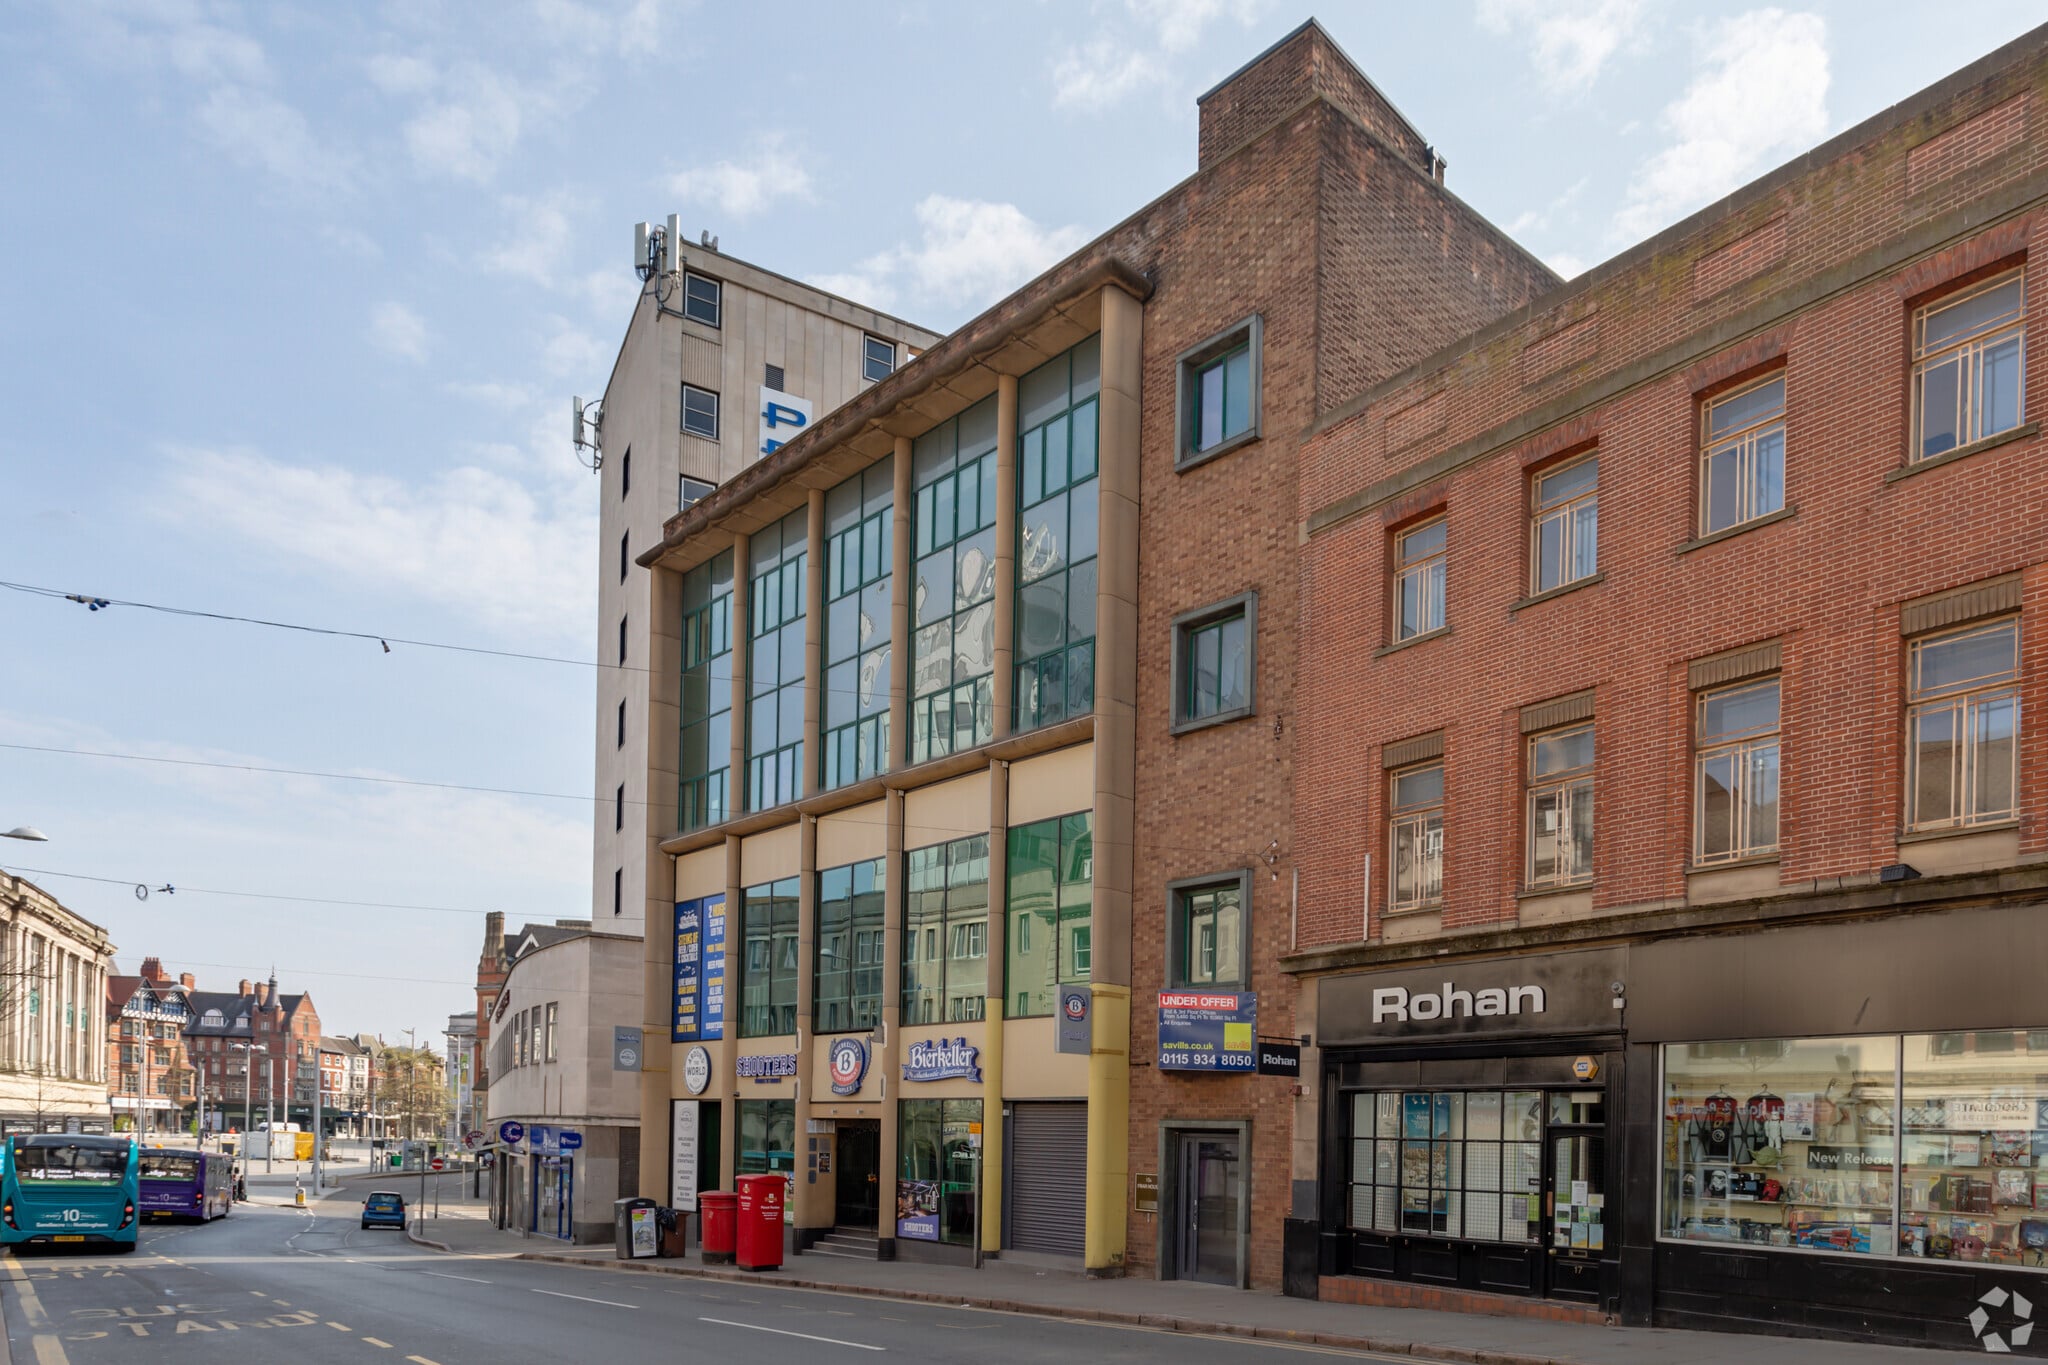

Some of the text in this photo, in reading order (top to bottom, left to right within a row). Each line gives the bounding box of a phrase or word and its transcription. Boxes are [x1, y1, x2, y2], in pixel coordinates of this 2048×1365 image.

[1162, 996, 1234, 1007] UNDER OFFER
[1373, 982, 1545, 1023] Rohan
[1163, 1042, 1214, 1050] savills.co.uk
[841, 1052, 851, 1072] B
[911, 1044, 973, 1068] Bierkeller
[1162, 1053, 1252, 1066] 0115 934 8050
[1263, 1053, 1297, 1067] Rohan
[687, 1067, 706, 1076] WORLD
[736, 1055, 796, 1076] SHOOTERS
[1809, 1152, 1895, 1166] New Releas
[31, 1169, 45, 1179] i4
[62, 1210, 80, 1221] 10
[904, 1222, 934, 1233] SHOOTERS
[1574, 1266, 1583, 1274] 17
